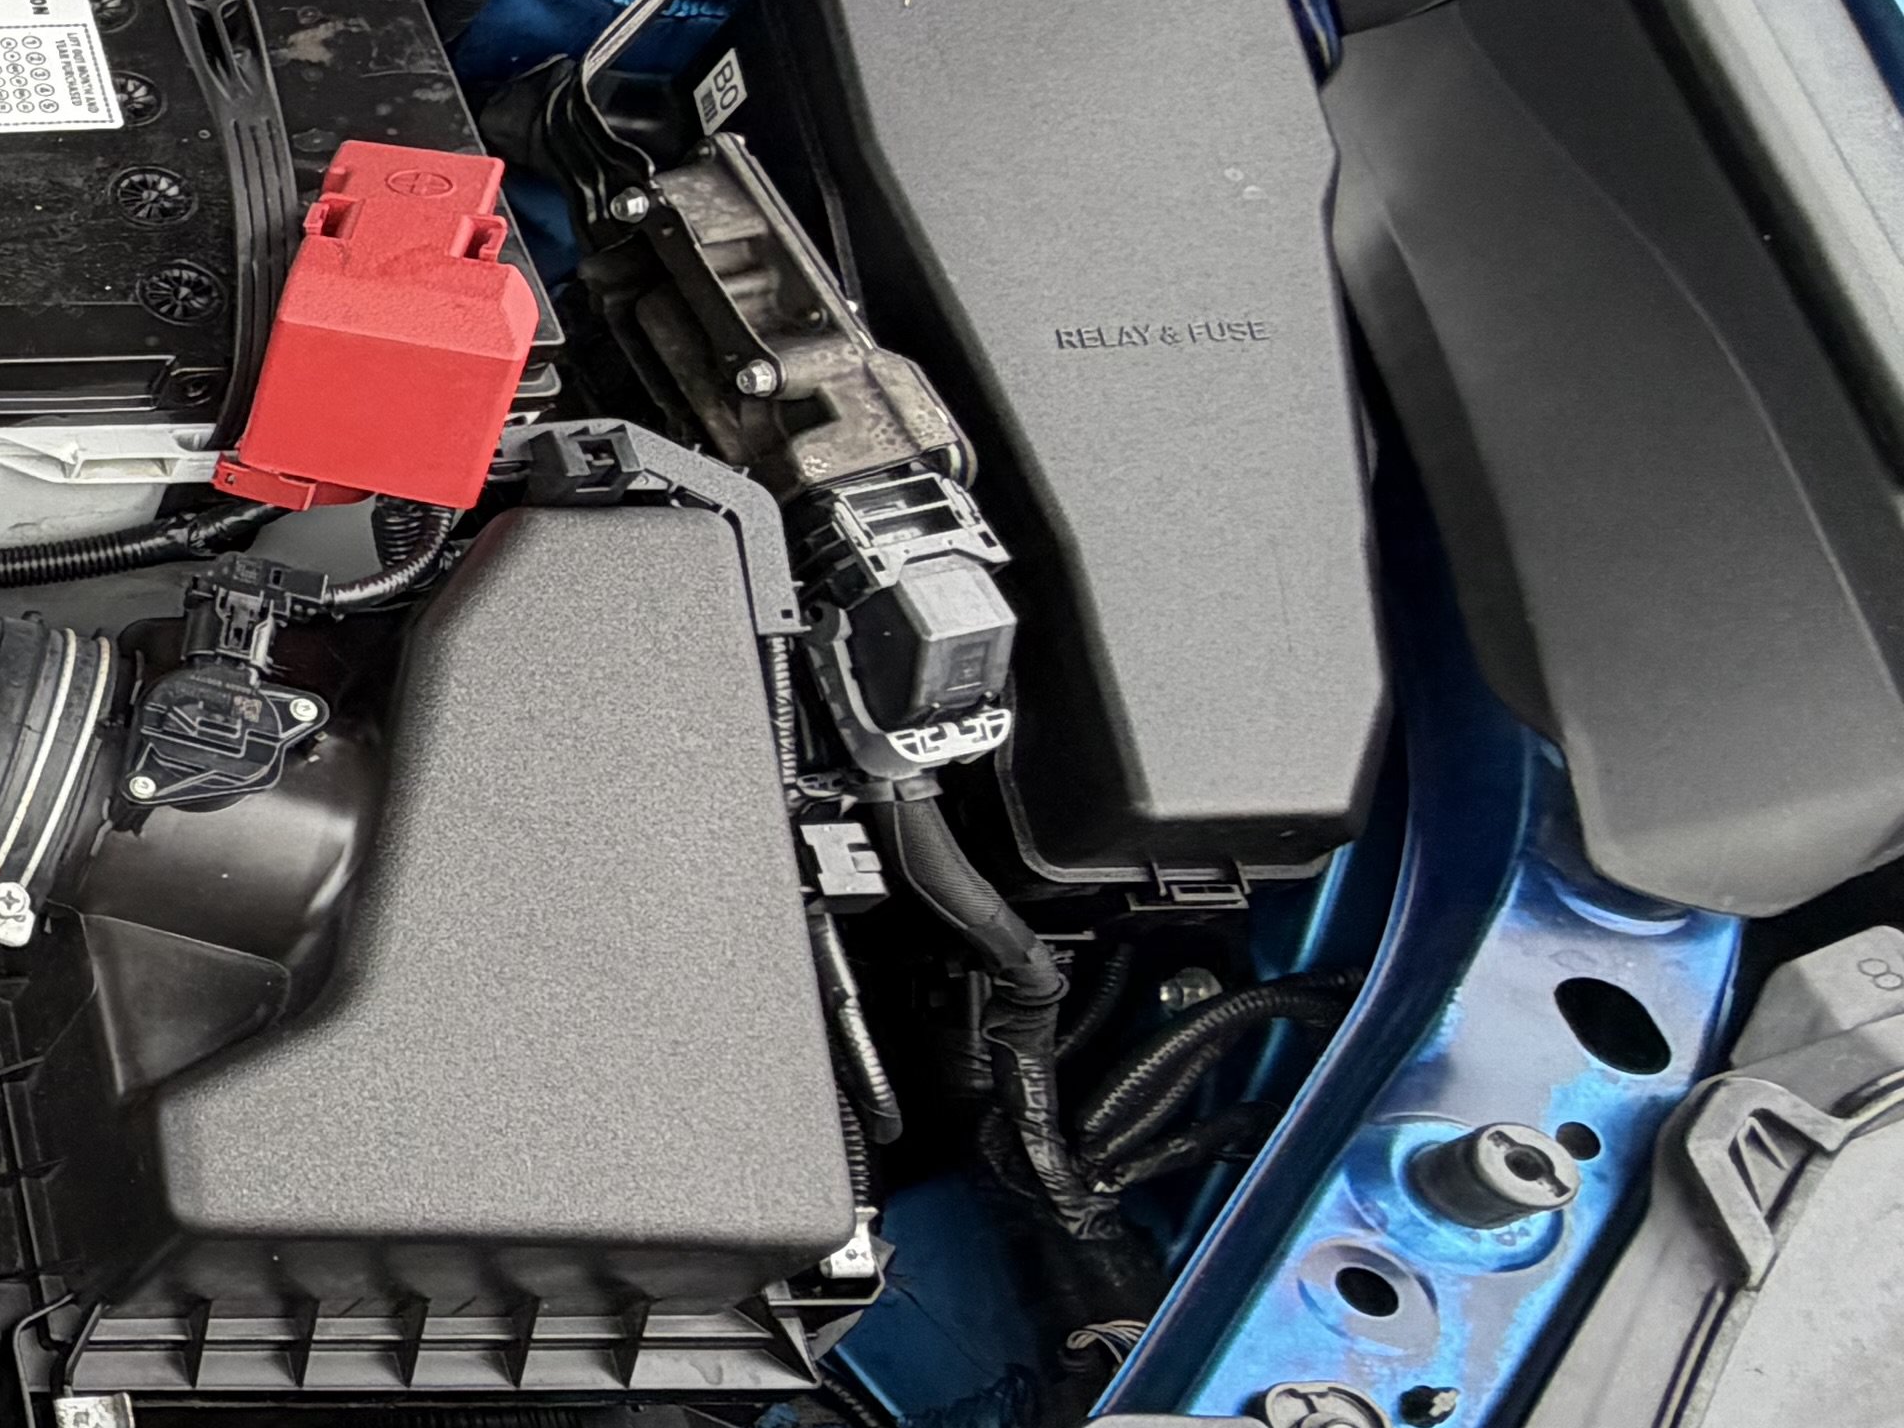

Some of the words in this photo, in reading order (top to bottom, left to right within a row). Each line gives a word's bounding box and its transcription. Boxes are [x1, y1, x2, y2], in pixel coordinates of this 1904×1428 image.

[61, 60, 82, 106] PURCHASED
[85, 95, 99, 113] AND
[1055, 324, 1150, 349] RELAY
[1159, 325, 1182, 345] &
[1188, 321, 1271, 343] FUSE
